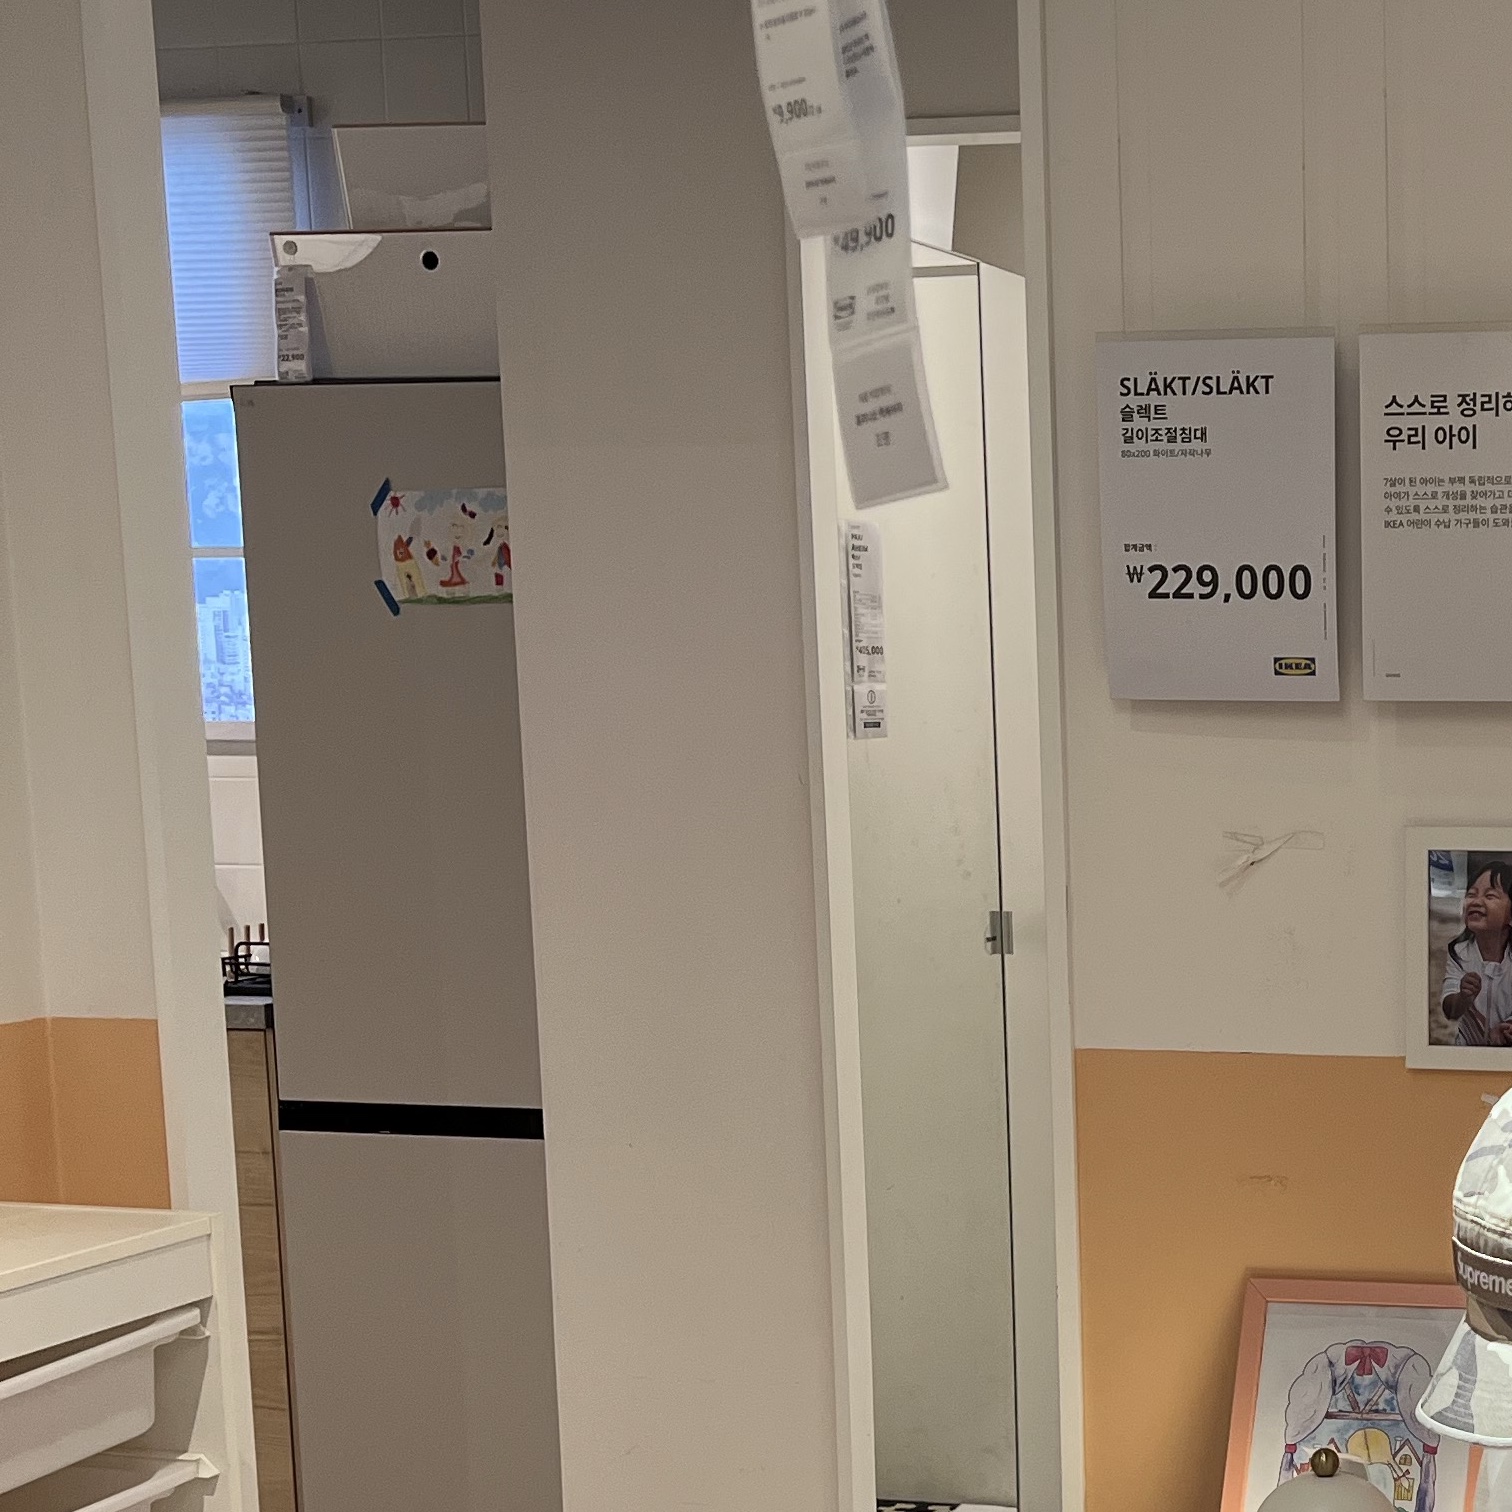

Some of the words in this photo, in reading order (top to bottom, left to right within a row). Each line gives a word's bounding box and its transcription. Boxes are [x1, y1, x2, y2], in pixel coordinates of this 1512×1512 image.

[1119, 370, 1274, 396] SLÄKT/SLÄKT
[1120, 404, 1168, 422] 슬렉트
[1384, 395, 1449, 416] 스스로
[1121, 426, 1207, 444] 길이조절침대
[1384, 425, 1426, 450] 우리
[1435, 424, 1476, 449] 아이
[1383, 477, 1405, 487] 7살이
[1419, 476, 1445, 486] 아이는
[1469, 476, 1512, 486] 독립적으로
[1413, 491, 1438, 500] 스스로
[1441, 490, 1466, 500] 개성을
[1470, 489, 1504, 500] 찾아가고
[1384, 505, 1392, 515] 수
[1395, 505, 1420, 514] 있도록
[1423, 505, 1449, 514] 스스로
[1453, 504, 1487, 514] 정리하는
[1384, 520, 1404, 528] IKEA
[1407, 518, 1431, 529] 어린이
[1434, 518, 1451, 529] 수납
[1454, 518, 1489, 528] 가구들이
[1125, 564, 1312, 603] ₩229,000
